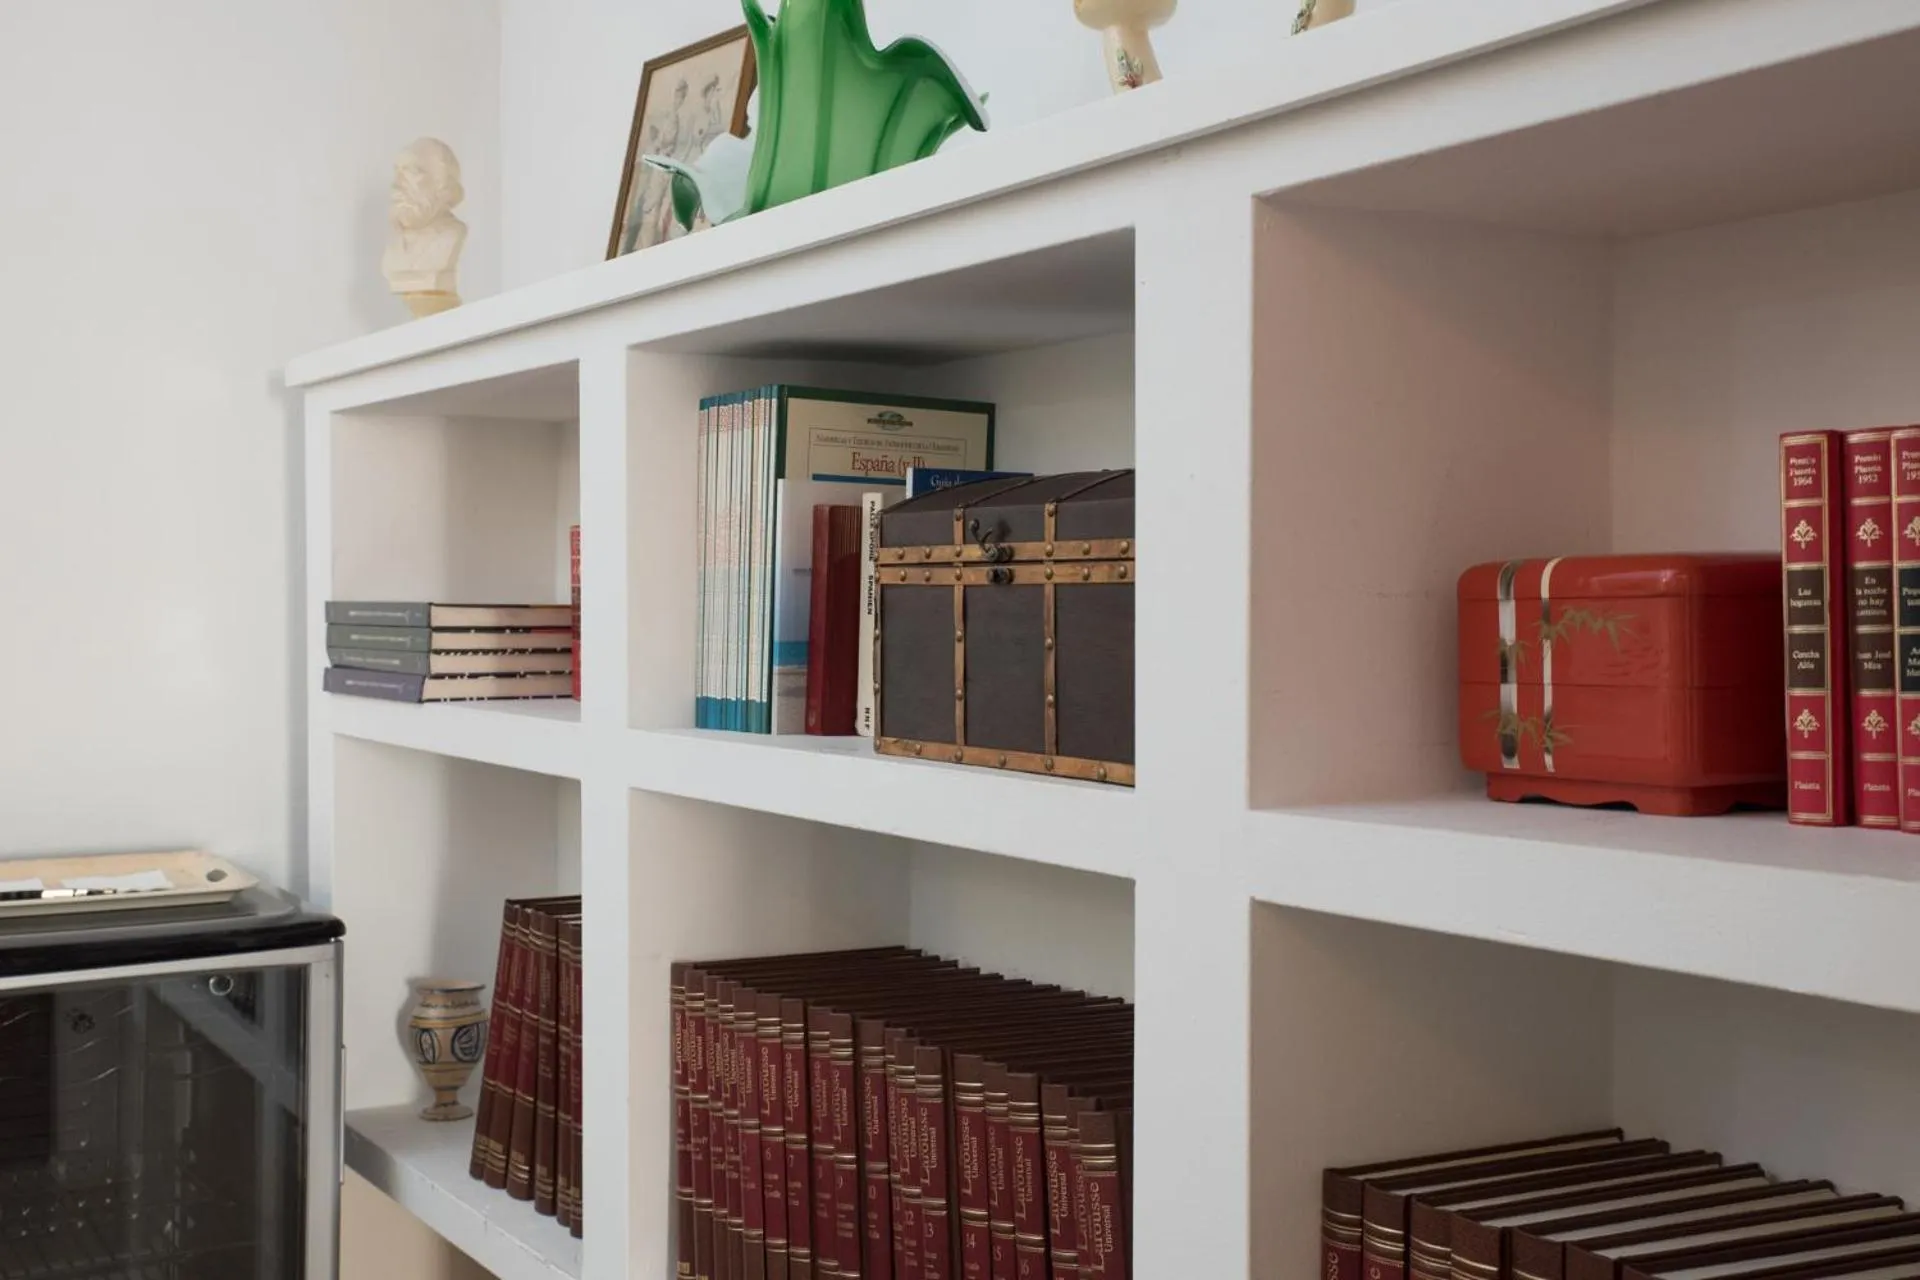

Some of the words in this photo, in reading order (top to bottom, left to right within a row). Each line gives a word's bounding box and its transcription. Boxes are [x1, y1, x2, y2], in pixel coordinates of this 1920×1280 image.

[852, 452, 896, 477] España
[866, 575, 874, 616] SPANIEN
[761, 1047, 770, 1116] Larousse
[785, 1053, 793, 1122] Larousse
[831, 1070, 841, 1142] Larousse
[863, 1077, 873, 1149] Larousse
[900, 1097, 910, 1175] Larousse
[919, 1108, 930, 1186] Larousse
[960, 1116, 972, 1196] Larousse
[988, 1127, 998, 1207] Larousse
[1014, 1136, 1026, 1221] Larousse
[1047, 1150, 1060, 1236] Larousse
[1058, 1173, 1069, 1218] Universal
[1090, 1182, 1105, 1274] Larousse
[1101, 1205, 1114, 1253] Universal
